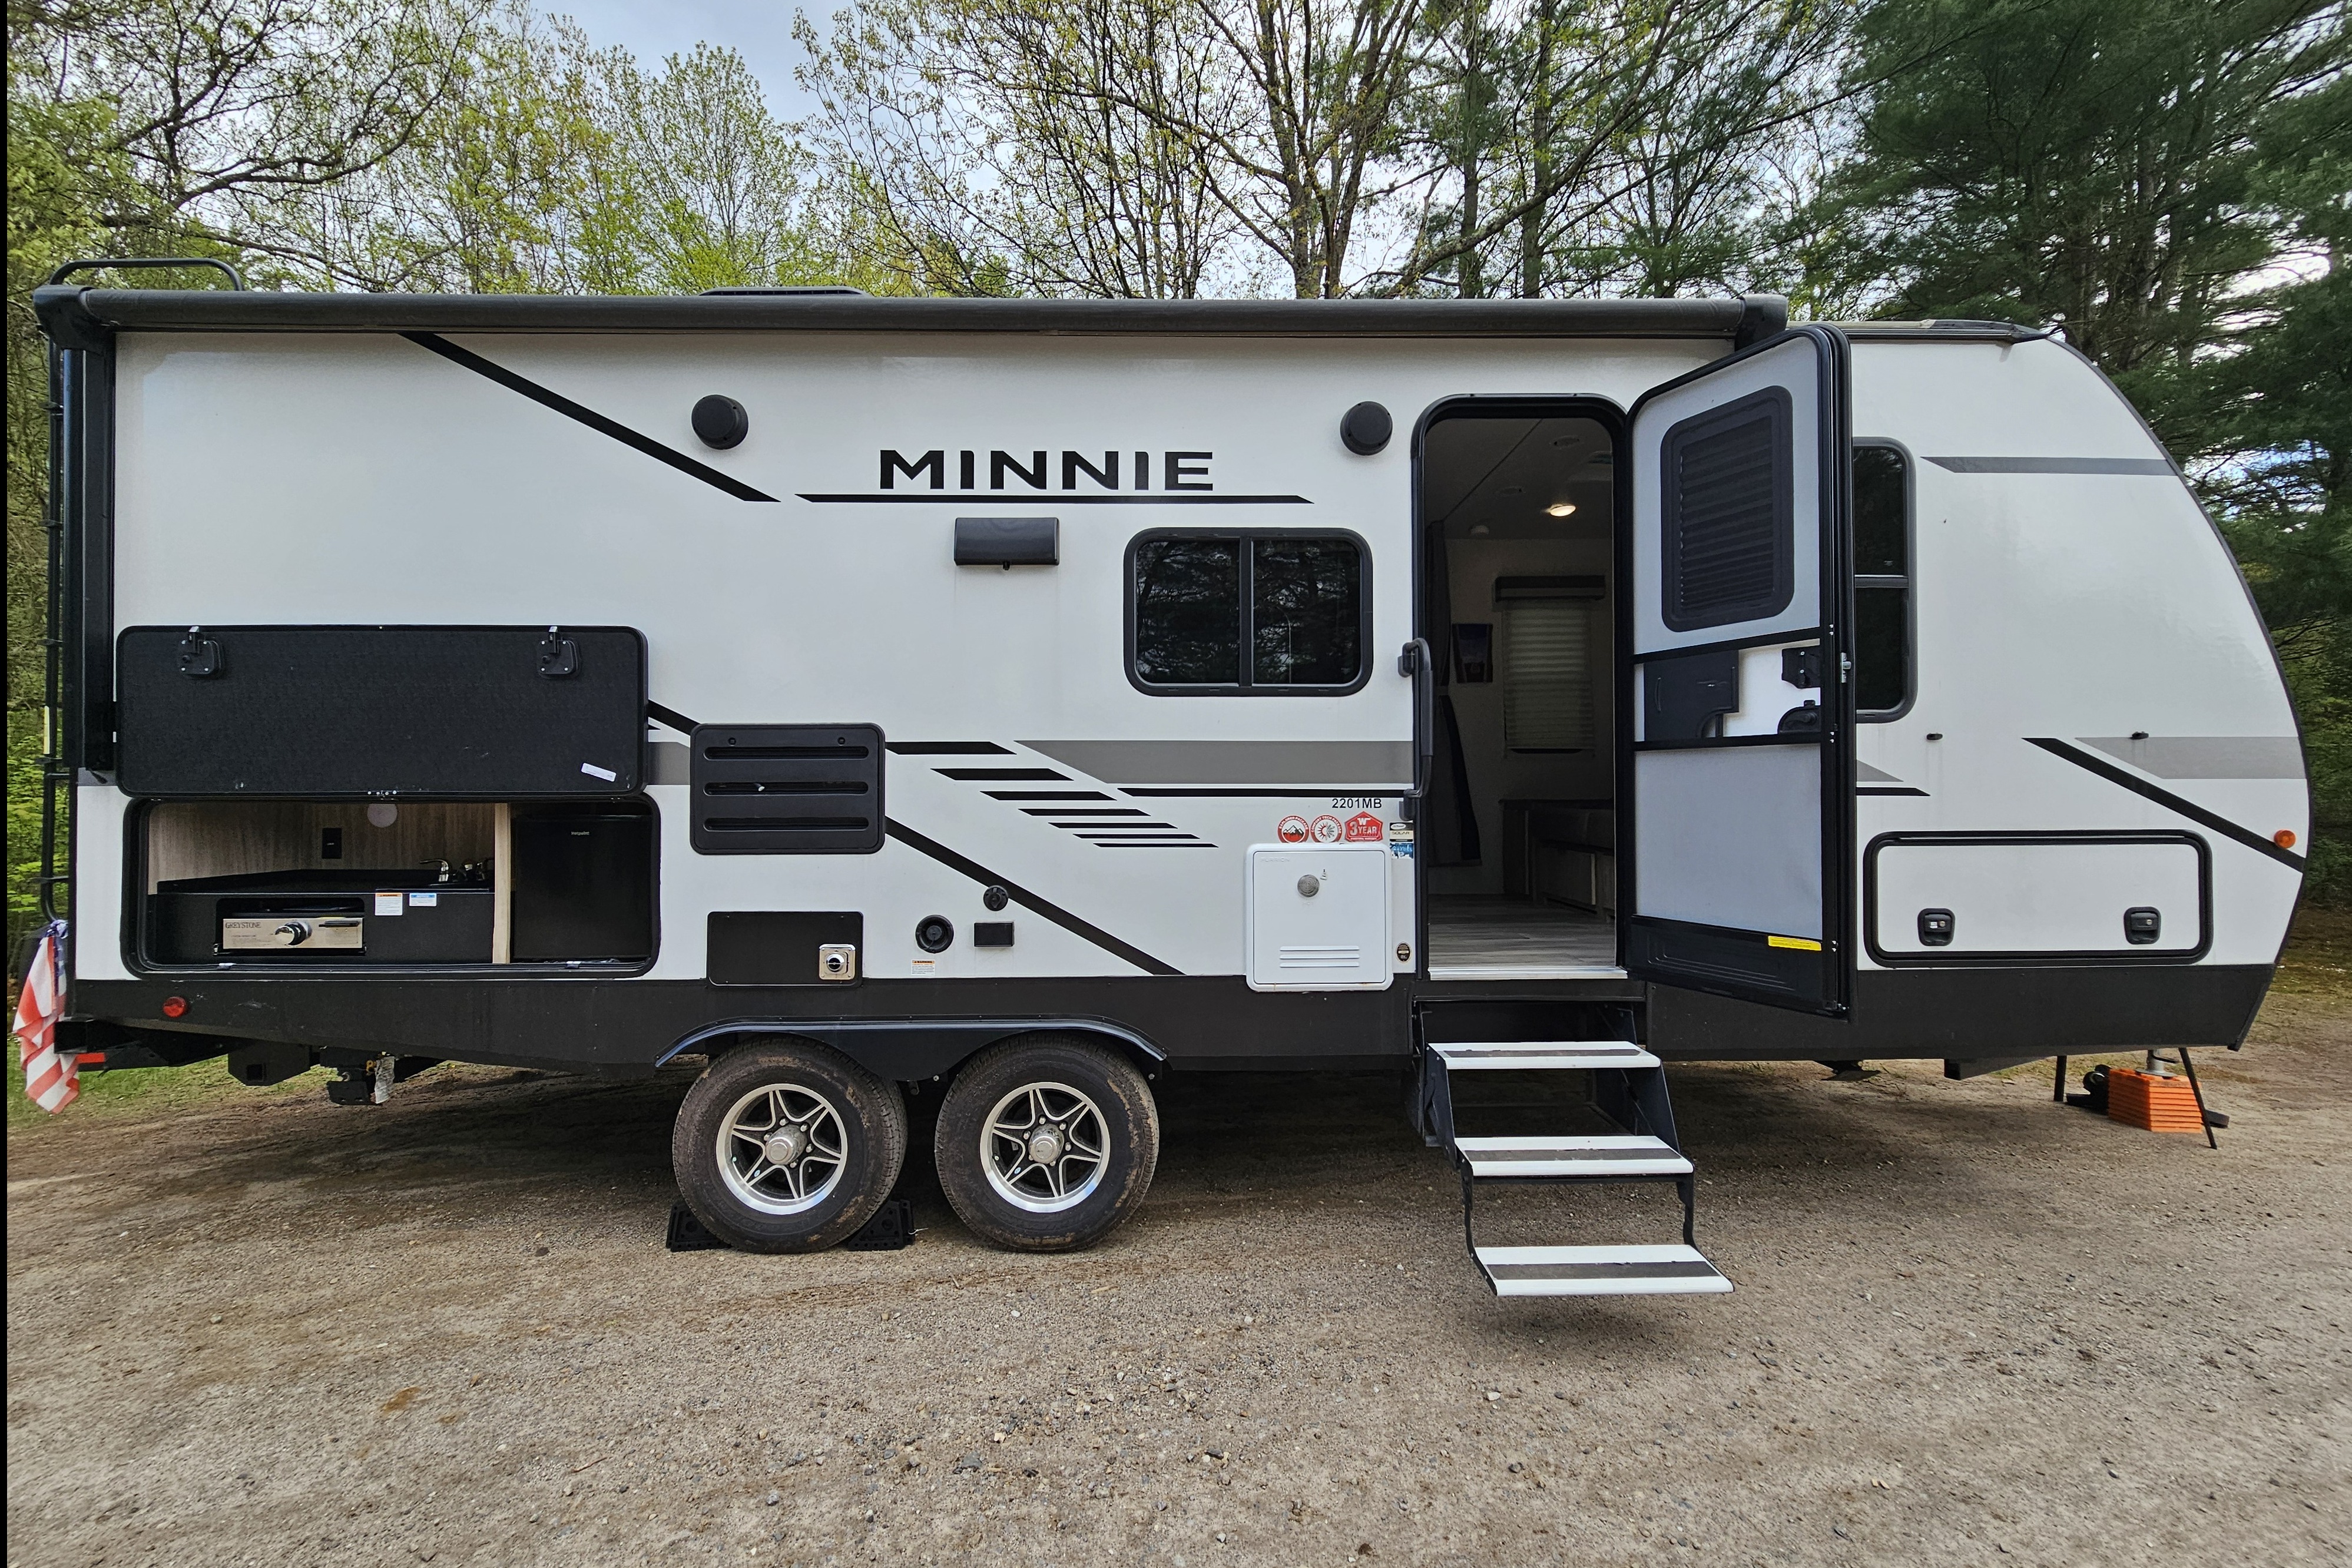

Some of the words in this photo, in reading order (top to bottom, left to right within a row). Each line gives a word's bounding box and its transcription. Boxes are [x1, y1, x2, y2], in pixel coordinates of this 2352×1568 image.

[880, 450, 1213, 491] MINNIE
[1332, 798, 1382, 808] 2201MB
[1311, 817, 1322, 833] COMFORT
[1349, 821, 1357, 836] 3
[1358, 826, 1377, 834] YEAR
